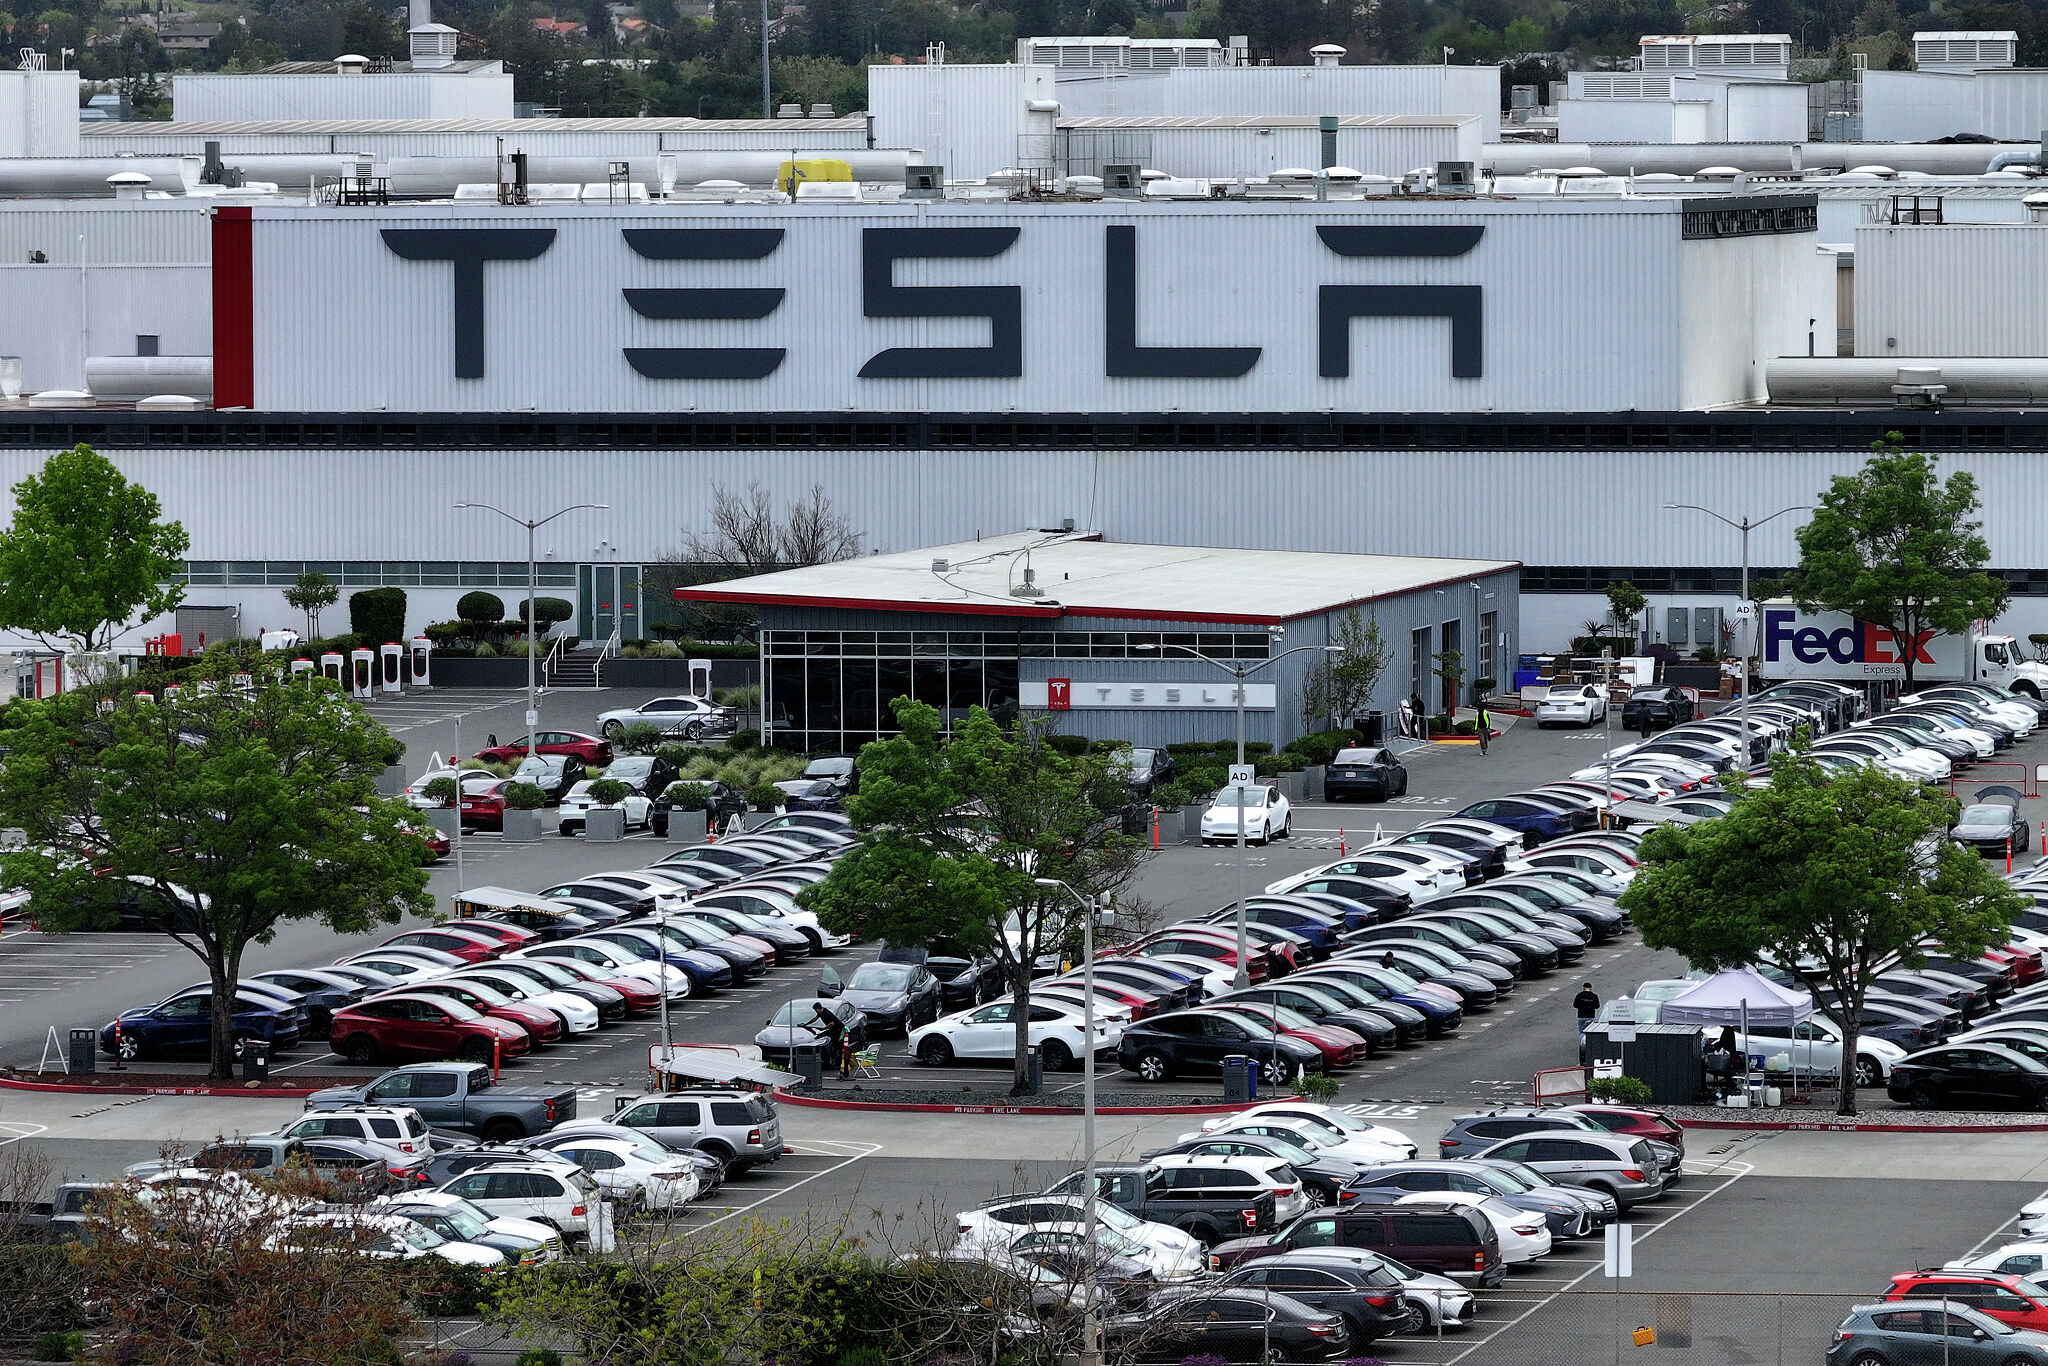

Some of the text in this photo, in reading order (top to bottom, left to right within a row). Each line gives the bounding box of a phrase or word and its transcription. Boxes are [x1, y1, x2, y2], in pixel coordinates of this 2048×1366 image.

[380, 225, 1485, 378] TESLA
[1736, 606, 1750, 614] AD
[1765, 609, 1937, 664] FedEx
[1863, 665, 1901, 675] Express
[1097, 688, 1247, 703] TESLA
[1231, 772, 1248, 781] AD
